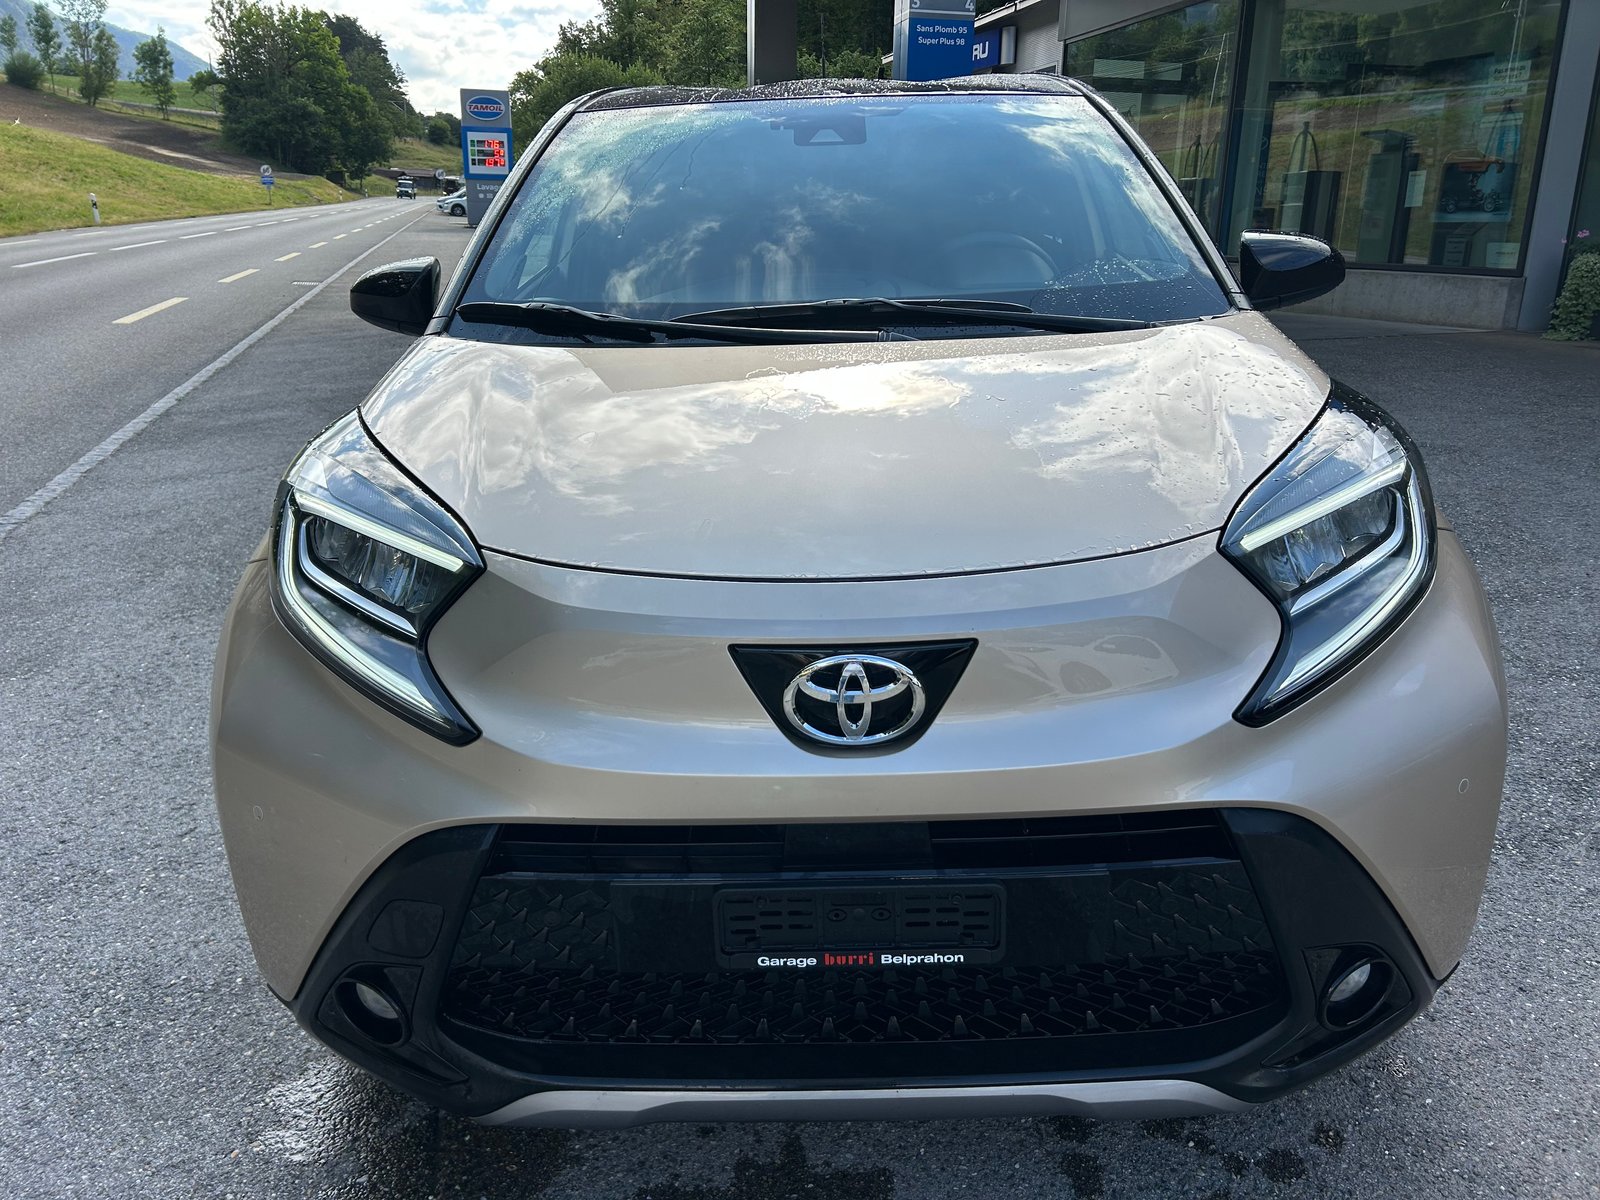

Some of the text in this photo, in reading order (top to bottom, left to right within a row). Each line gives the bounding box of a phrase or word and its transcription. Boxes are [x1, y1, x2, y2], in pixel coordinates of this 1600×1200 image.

[965, 0, 975, 11] 4
[917, 25, 968, 34] Sans Plomb 95
[918, 37, 965, 46] Super Plus 98
[476, 183, 501, 192] Lavag
[757, 952, 965, 968] Garage burri Belprahon
